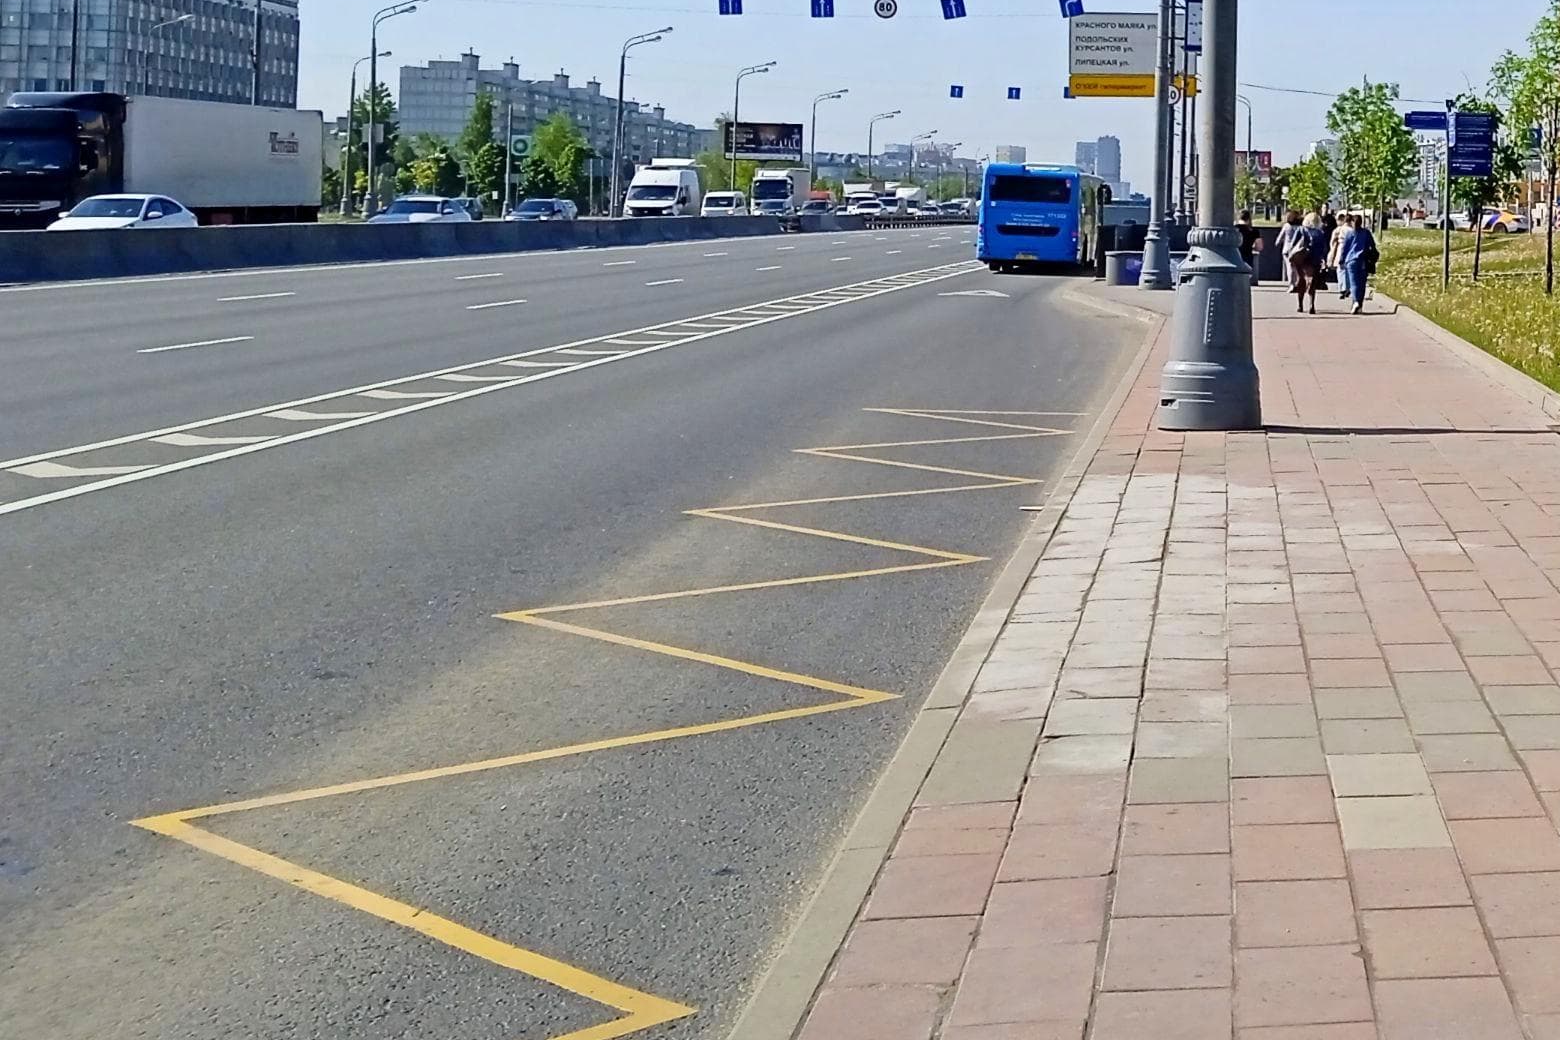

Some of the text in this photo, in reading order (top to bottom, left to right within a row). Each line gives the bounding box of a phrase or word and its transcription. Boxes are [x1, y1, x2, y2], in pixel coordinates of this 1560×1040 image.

[879, 2, 893, 12] 80
[1075, 35, 1129, 43] ПОДОЛЬСКИХ
[1074, 58, 1118, 66] ЛИПЕЦКАЯ
